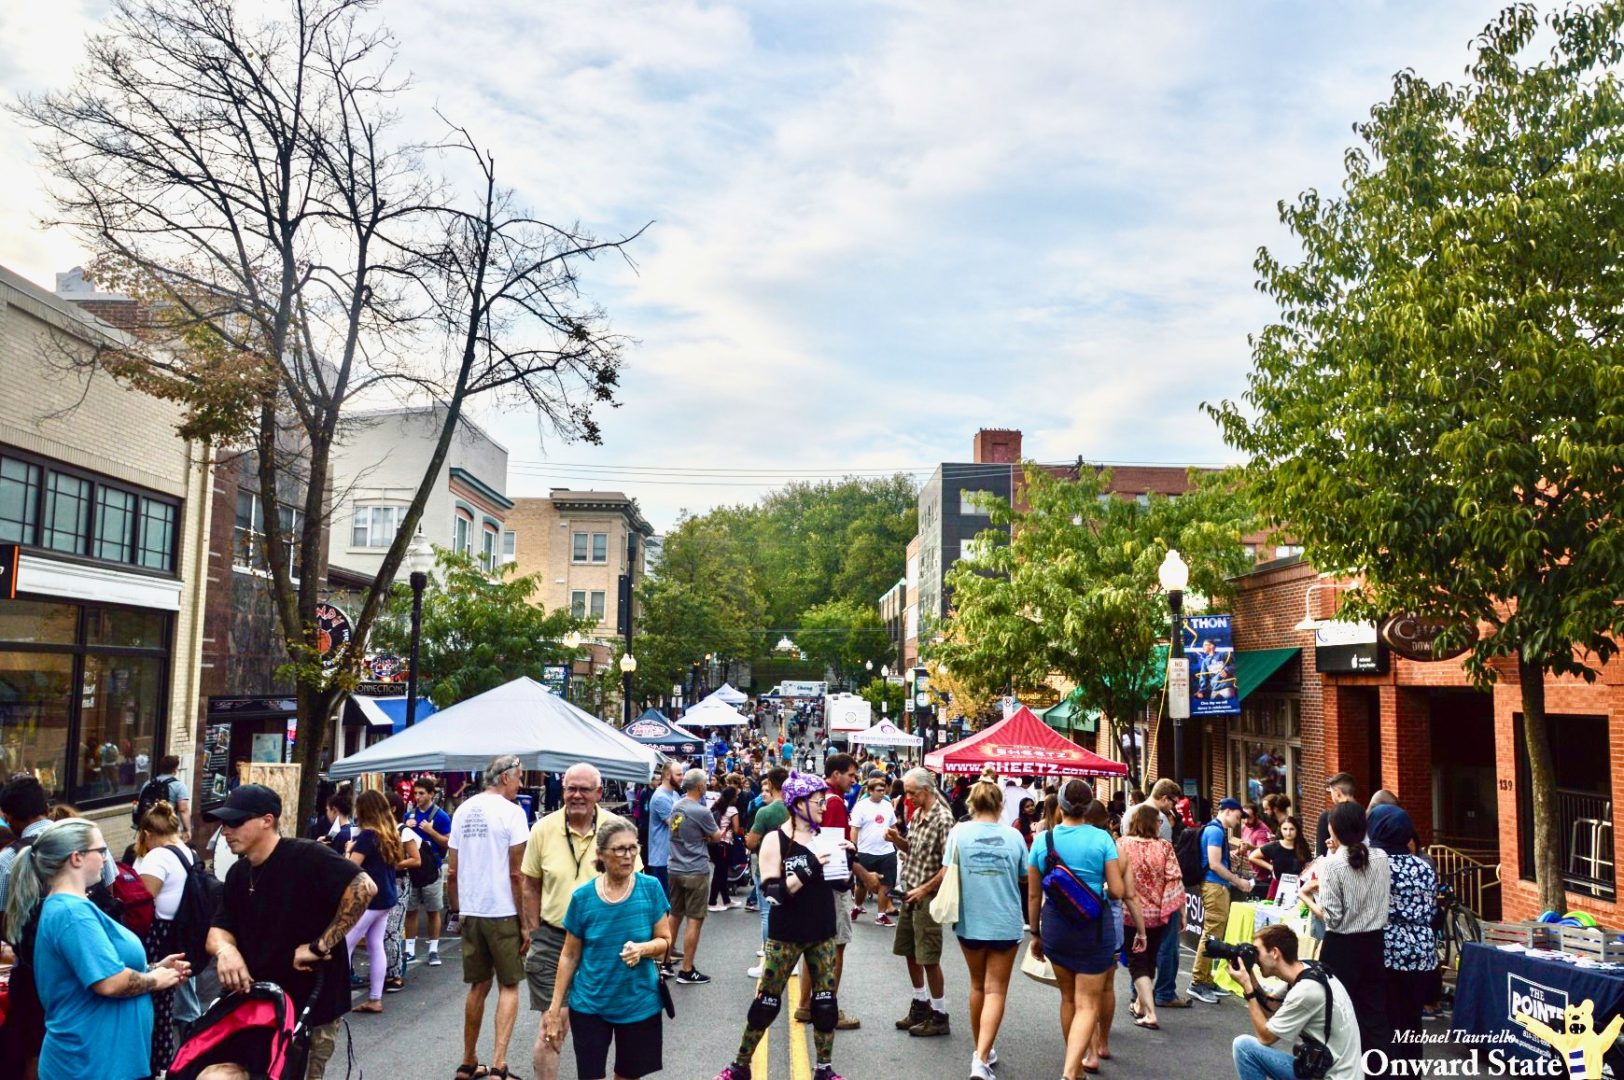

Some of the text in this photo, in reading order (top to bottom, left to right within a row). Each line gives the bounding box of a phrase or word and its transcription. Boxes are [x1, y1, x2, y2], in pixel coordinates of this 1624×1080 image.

[1191, 617, 1228, 629] THON
[996, 748, 1067, 758] SHEETZ
[1500, 779, 1513, 791] 139
[1185, 893, 1205, 923] PSU
[1529, 986, 1545, 1001] THE
[1511, 991, 1565, 1023] POINTE
